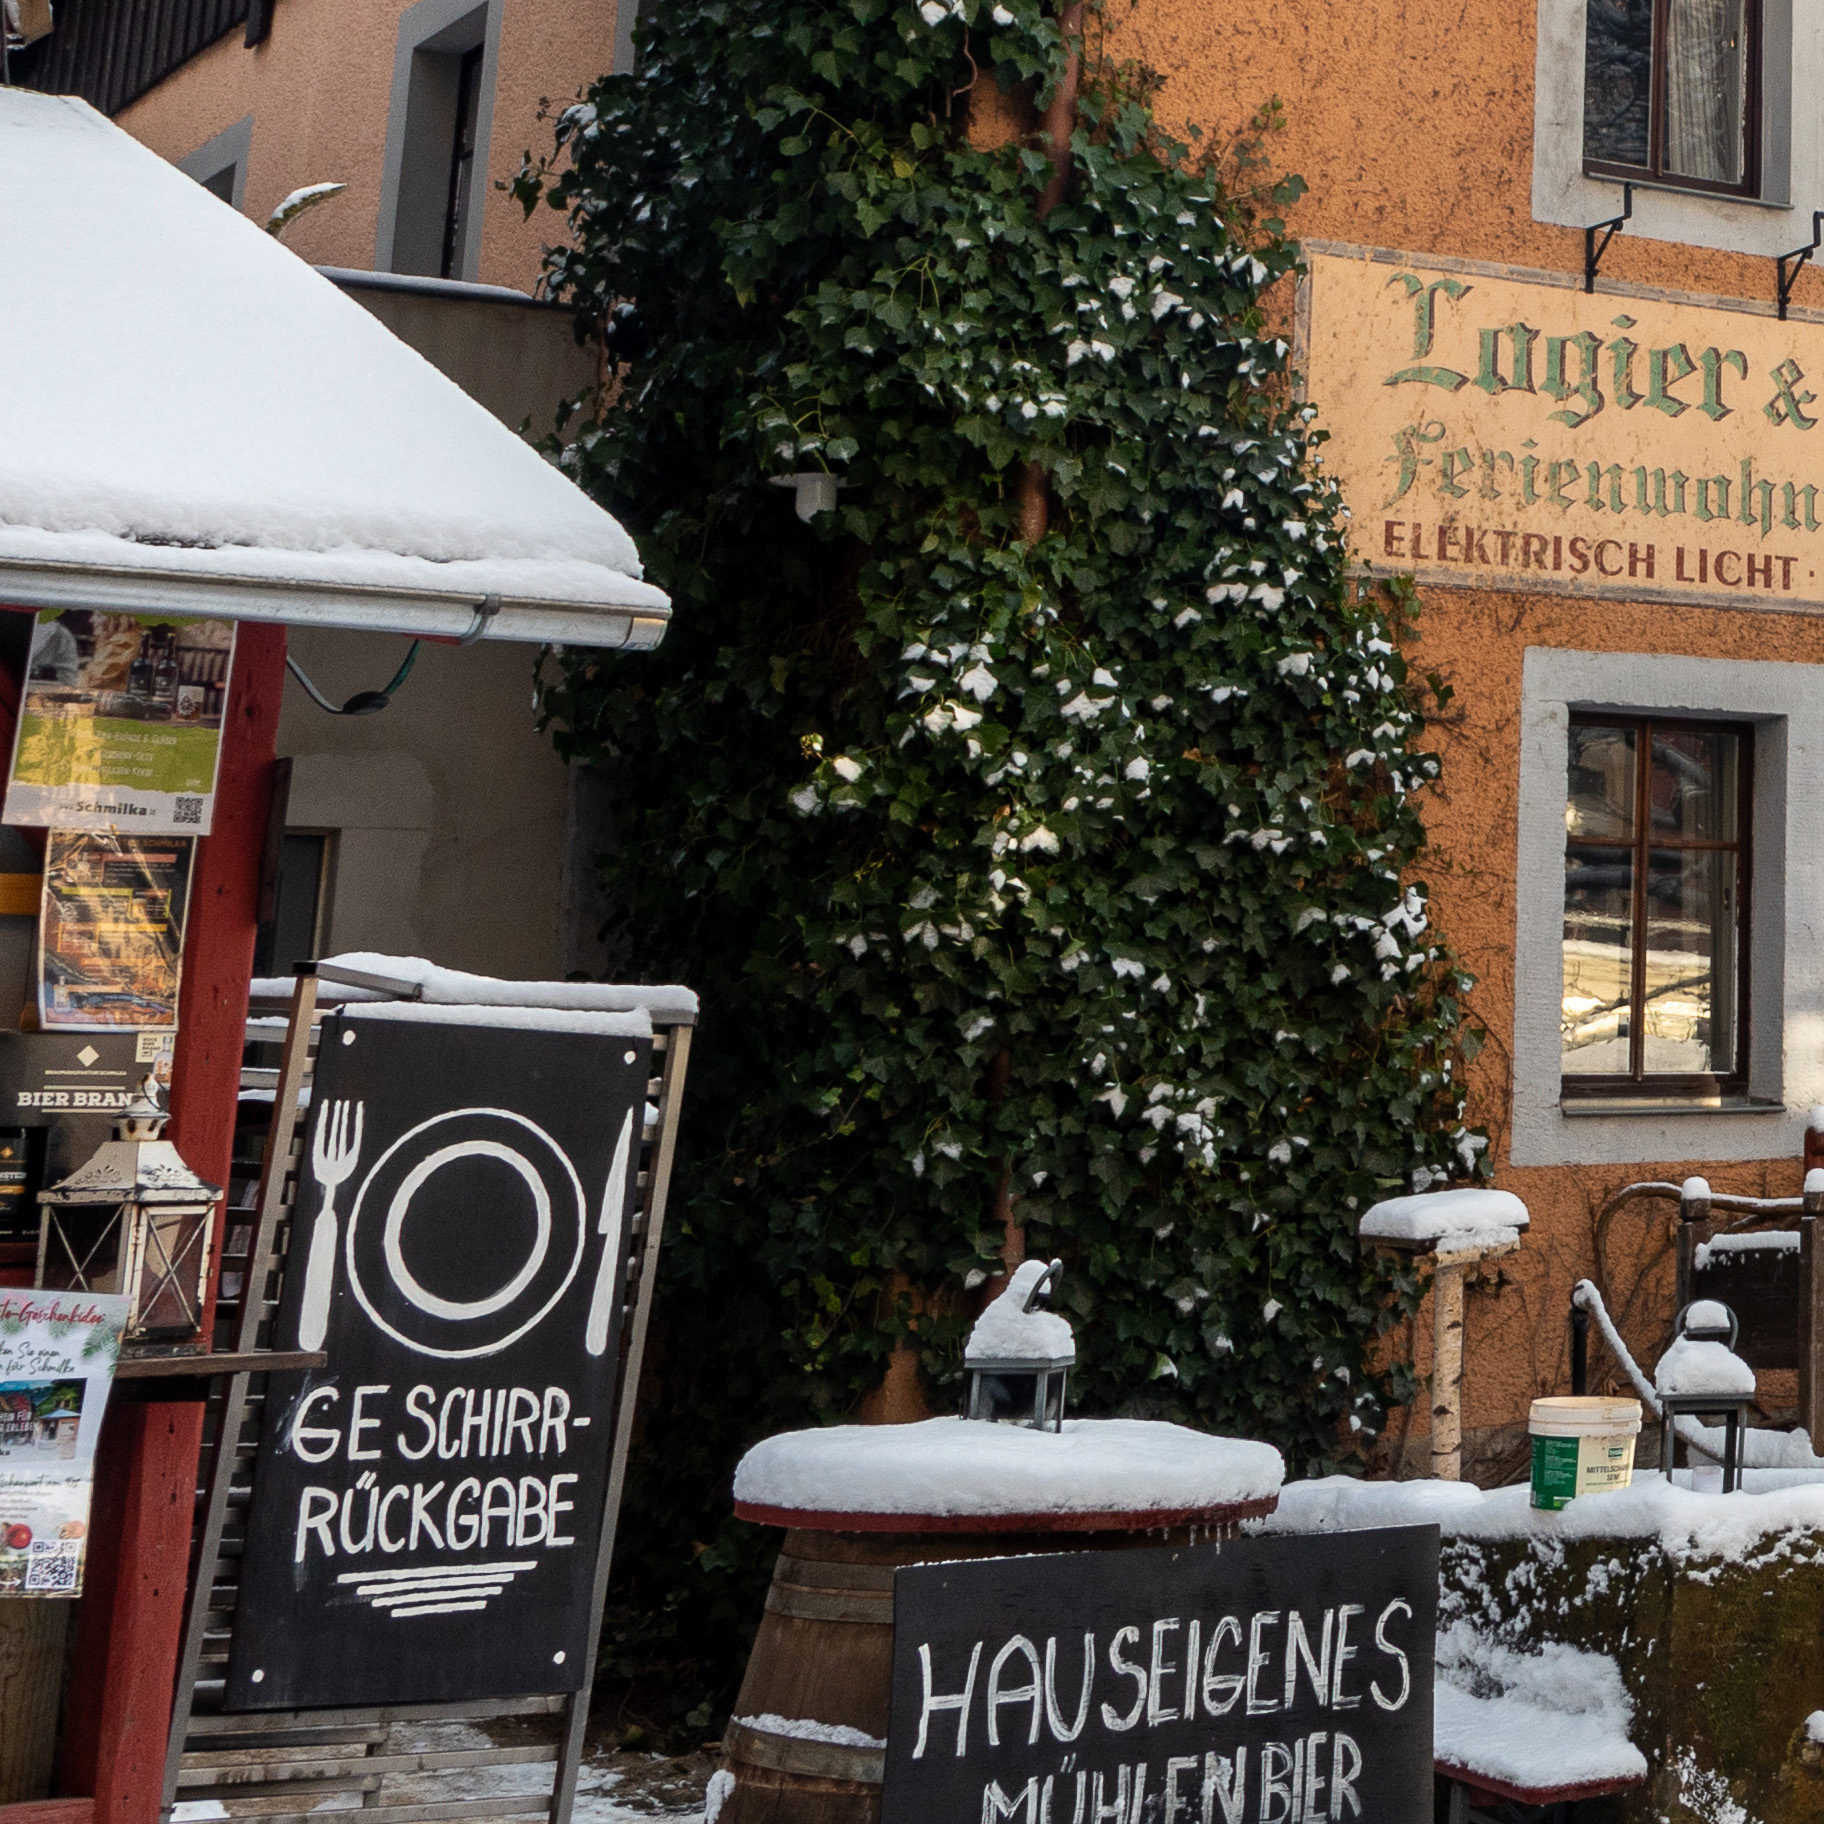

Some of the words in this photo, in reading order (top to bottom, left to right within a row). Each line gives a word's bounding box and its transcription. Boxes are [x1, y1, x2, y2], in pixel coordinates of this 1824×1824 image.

[1763, 358, 1819, 430] &
[1383, 519, 1656, 579] ELEKTRISCH
[1675, 545, 1799, 590] LICHT
[17, 1091, 70, 1107] BIER
[73, 1091, 137, 1107] BRAN
[294, 1470, 580, 1564] RÜCKGABE
[911, 1596, 1413, 1760] HAUSEIGENES
